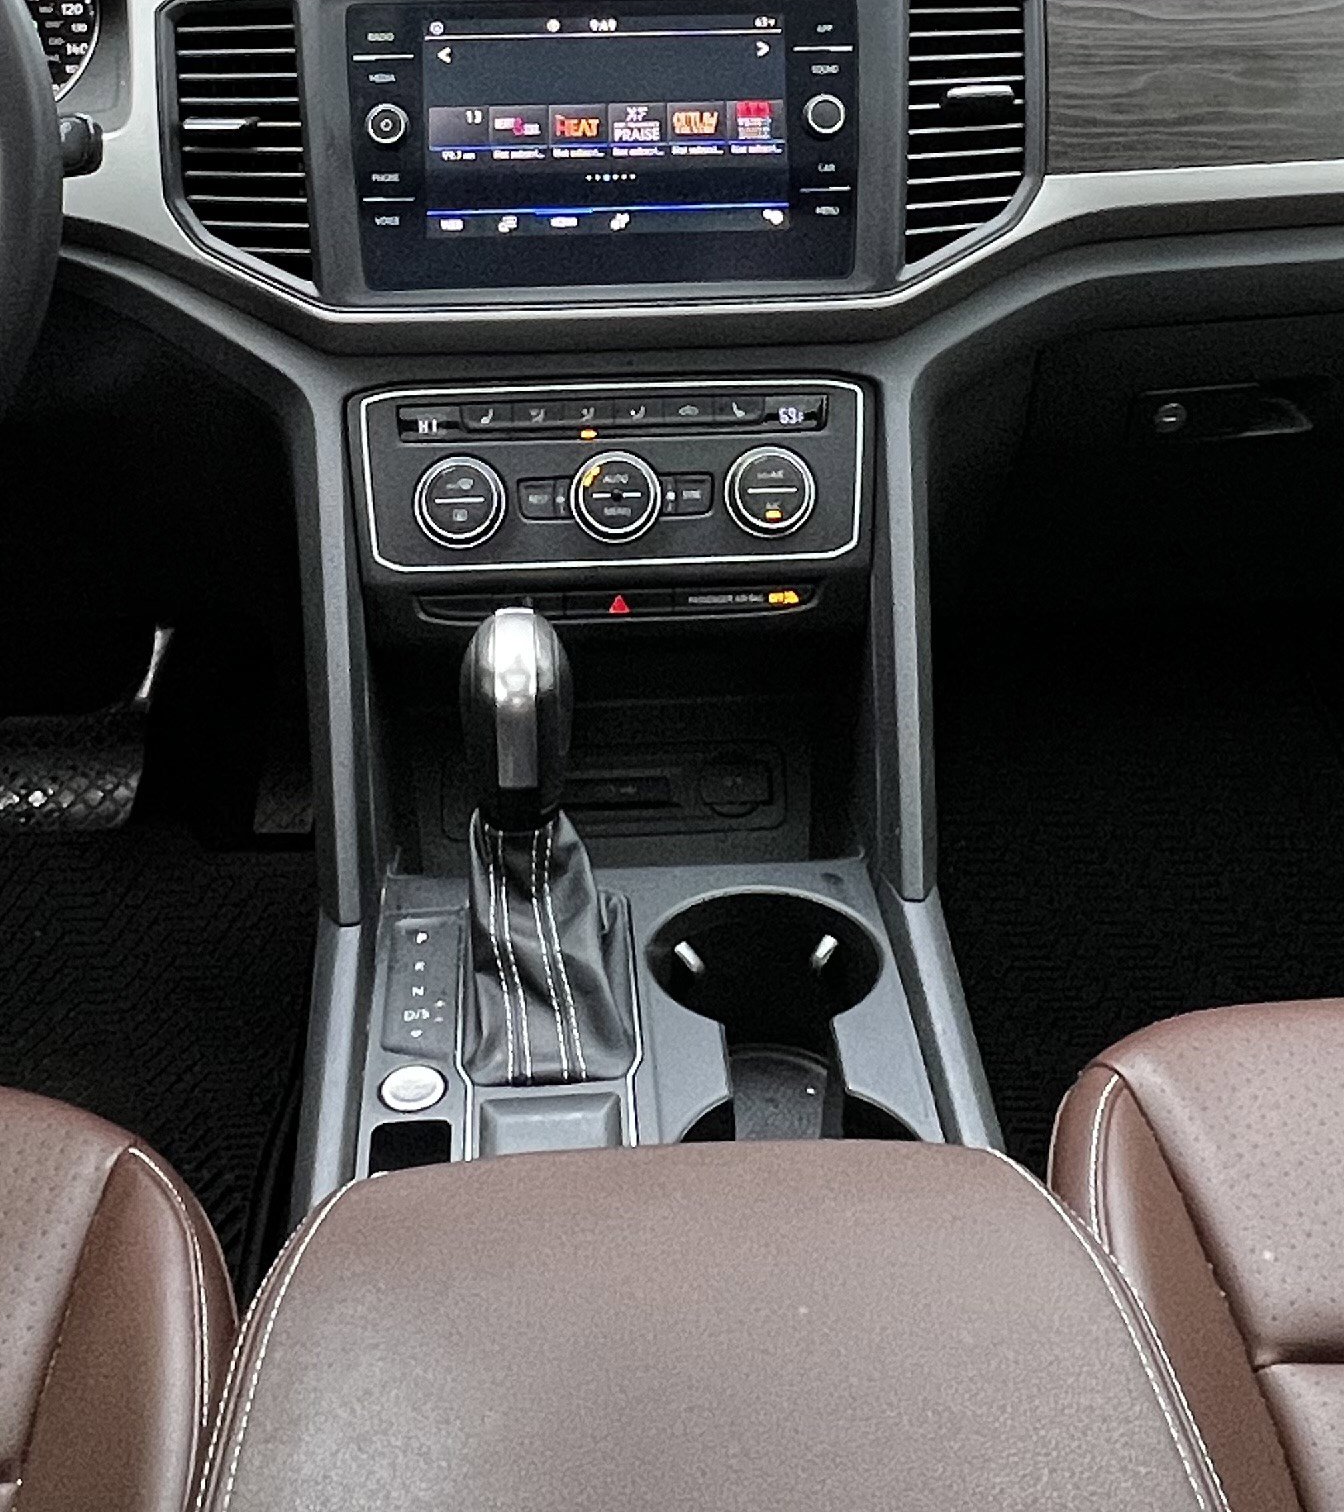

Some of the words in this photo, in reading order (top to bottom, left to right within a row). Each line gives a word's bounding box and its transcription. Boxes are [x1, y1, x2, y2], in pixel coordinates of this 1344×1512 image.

[61, 3, 84, 16] 120
[555, 117, 600, 137] HEAT
[613, 127, 660, 141] PRAISE
[412, 986, 425, 997] N
